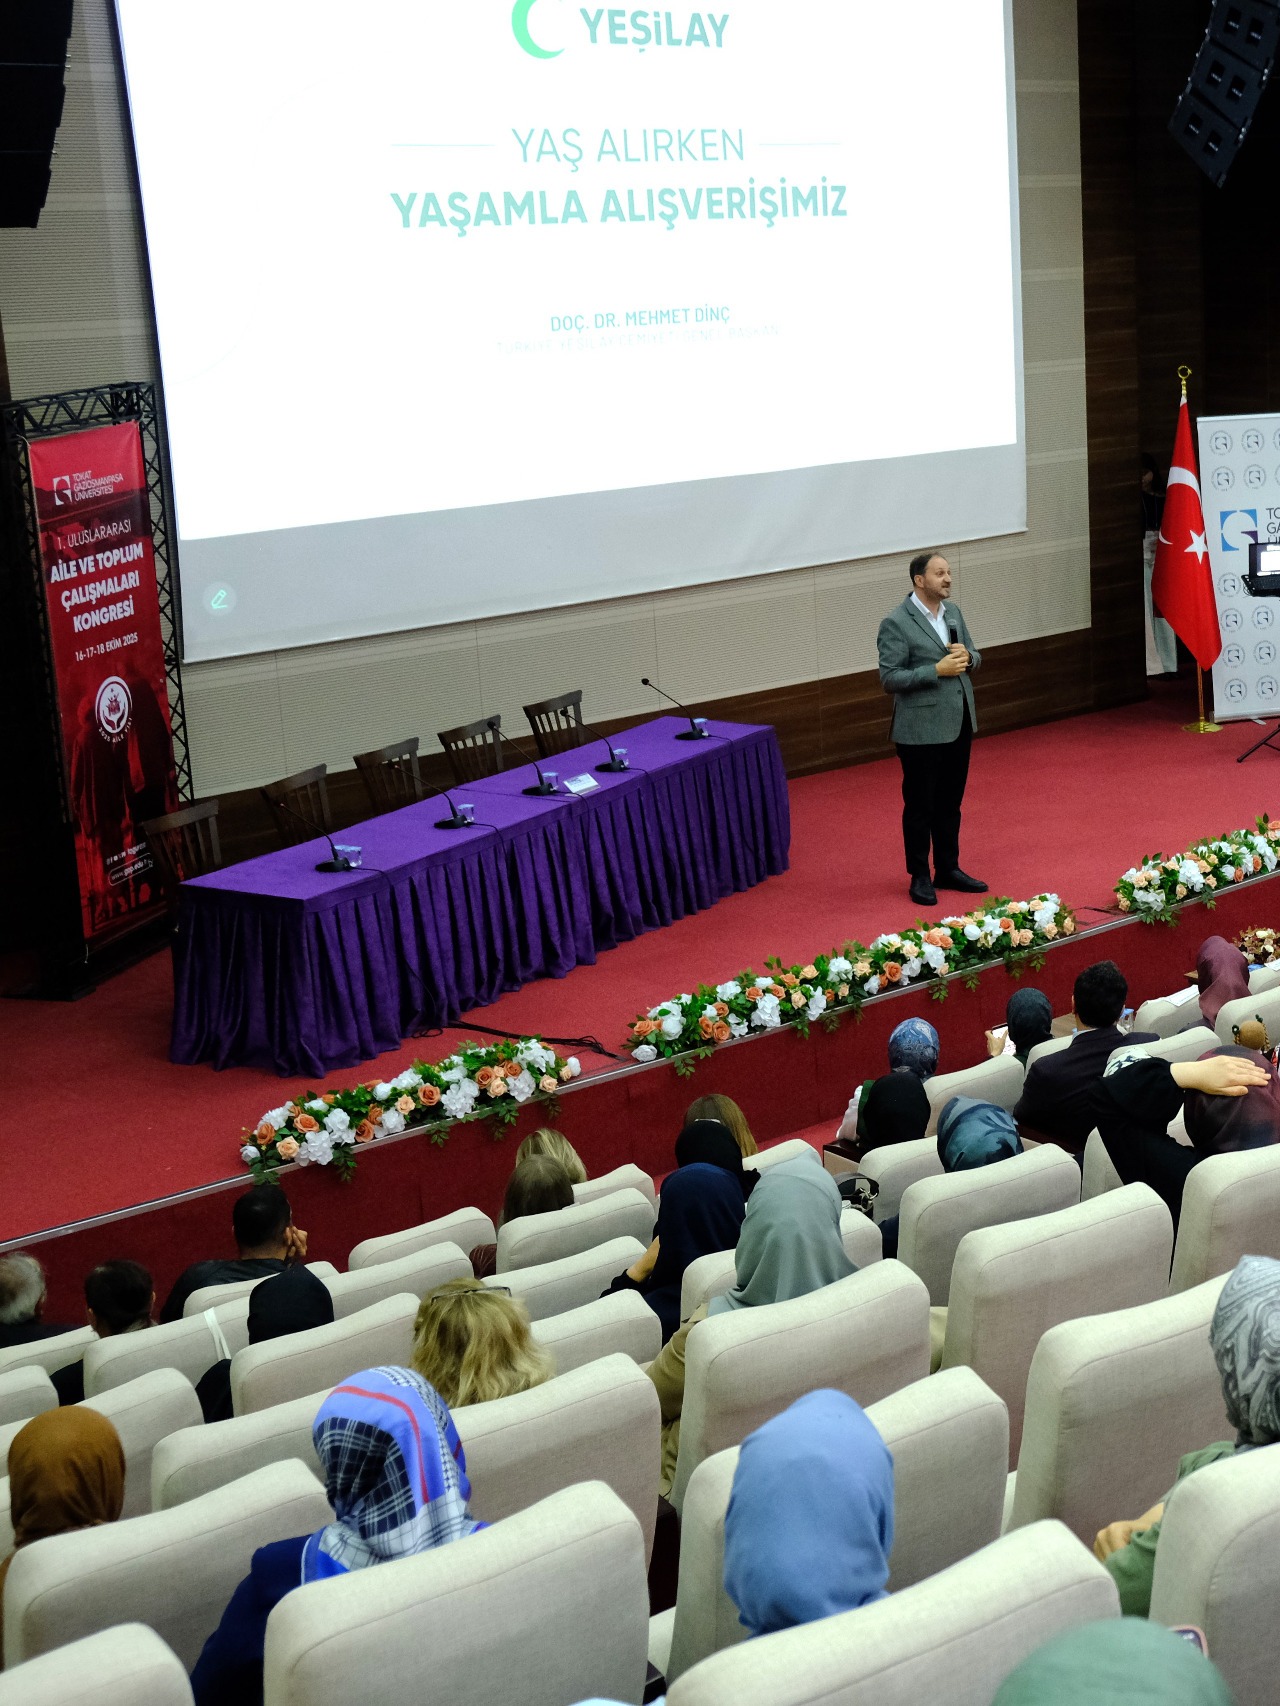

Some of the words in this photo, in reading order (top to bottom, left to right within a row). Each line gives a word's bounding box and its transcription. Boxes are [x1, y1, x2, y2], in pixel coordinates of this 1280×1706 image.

[579, 7, 730, 54] YEŞİLAY
[511, 127, 584, 173] YAŞ
[597, 127, 745, 163] ALIRKEN
[390, 189, 588, 238] YAŞAMLA
[600, 175, 848, 231] ALIŞVERİŞİMİZ
[550, 313, 590, 334] DOÇ.
[594, 311, 620, 328] DR.
[625, 307, 691, 326] MEHMET
[695, 302, 731, 325] DİNÇ
[72, 470, 92, 482] TOKAT
[57, 536, 67, 550] 1.
[67, 518, 132, 548] ULUSLARARASI
[50, 558, 78, 584] AİLE
[78, 554, 96, 575] VE
[95, 541, 144, 570] TOPLUM
[61, 569, 140, 613] ÇALIŞMALARI
[73, 594, 135, 633] KONGRESİ
[75, 643, 106, 662] 16-17-18
[105, 636, 123, 652] EKİM
[122, 631, 139, 647] 2025
